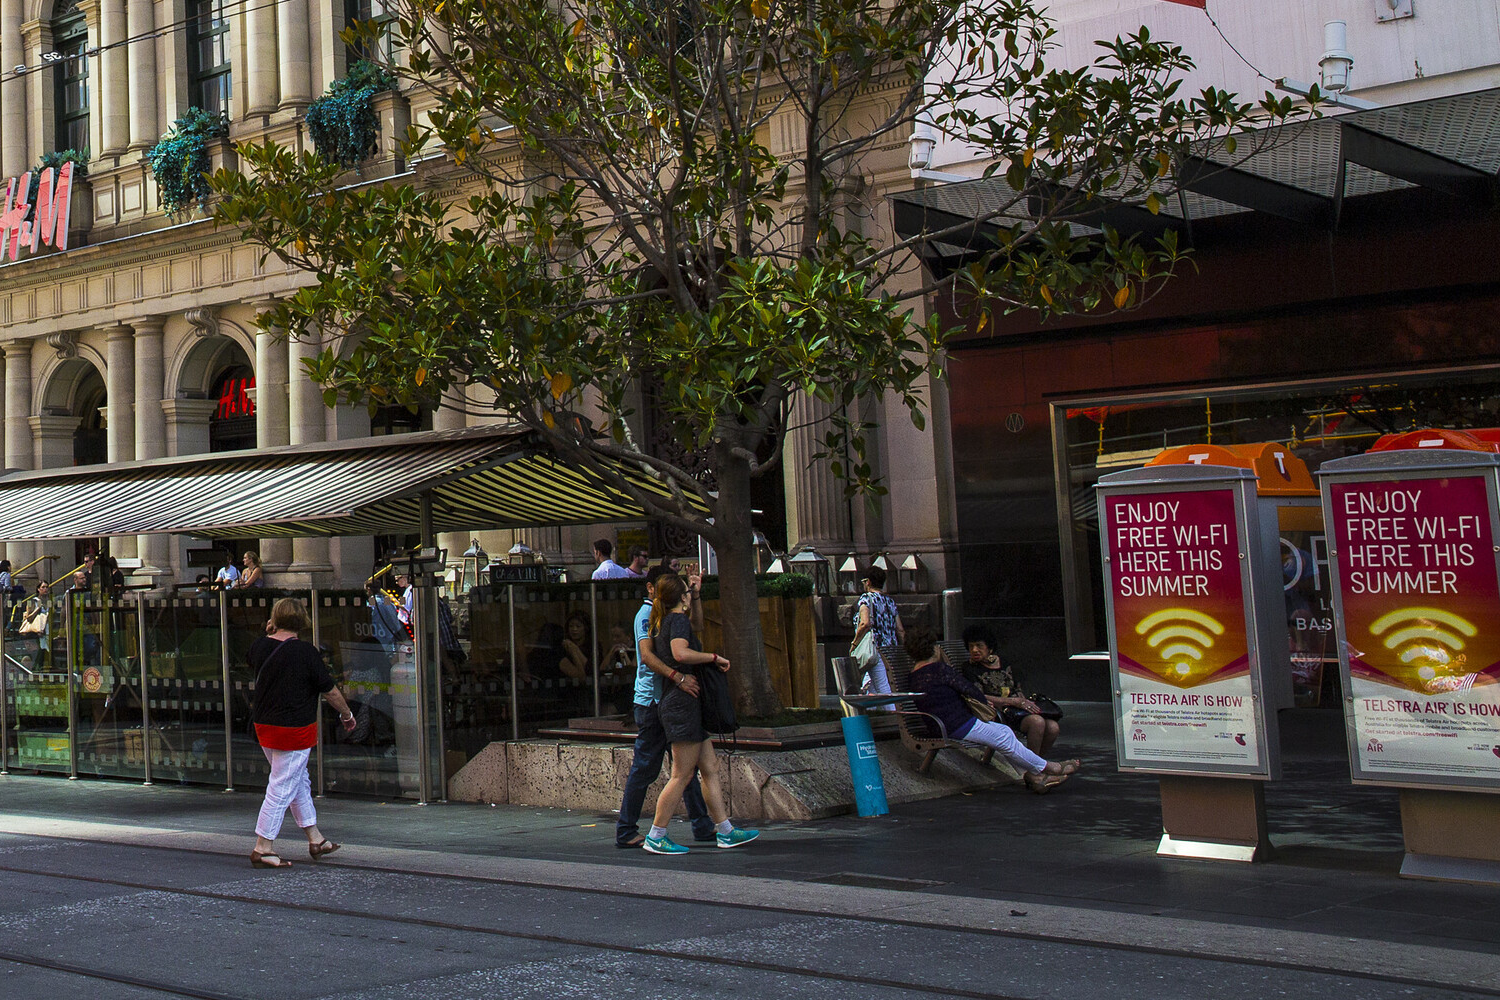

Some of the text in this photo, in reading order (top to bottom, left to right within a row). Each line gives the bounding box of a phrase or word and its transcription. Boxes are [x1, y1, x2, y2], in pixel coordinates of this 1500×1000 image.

[1115, 501, 1180, 524] ENJOY
[1344, 490, 1421, 514] ENJOY
[1117, 524, 1228, 548] FREE WI-FI
[1346, 515, 1481, 540] FREE WI-FI
[1119, 549, 1223, 572] HERE THIS
[1349, 544, 1413, 567] HERE
[1418, 543, 1475, 567] THIS
[1120, 575, 1209, 597] SUMMER
[1350, 571, 1458, 594] SUMMER
[1130, 693, 1178, 705] TELSTRA
[1204, 695, 1214, 707] IS
[1216, 696, 1243, 707] HOW
[1363, 699, 1421, 713] TELSTRA
[1453, 703, 1466, 715] IS
[1469, 703, 1500, 717] HOW
